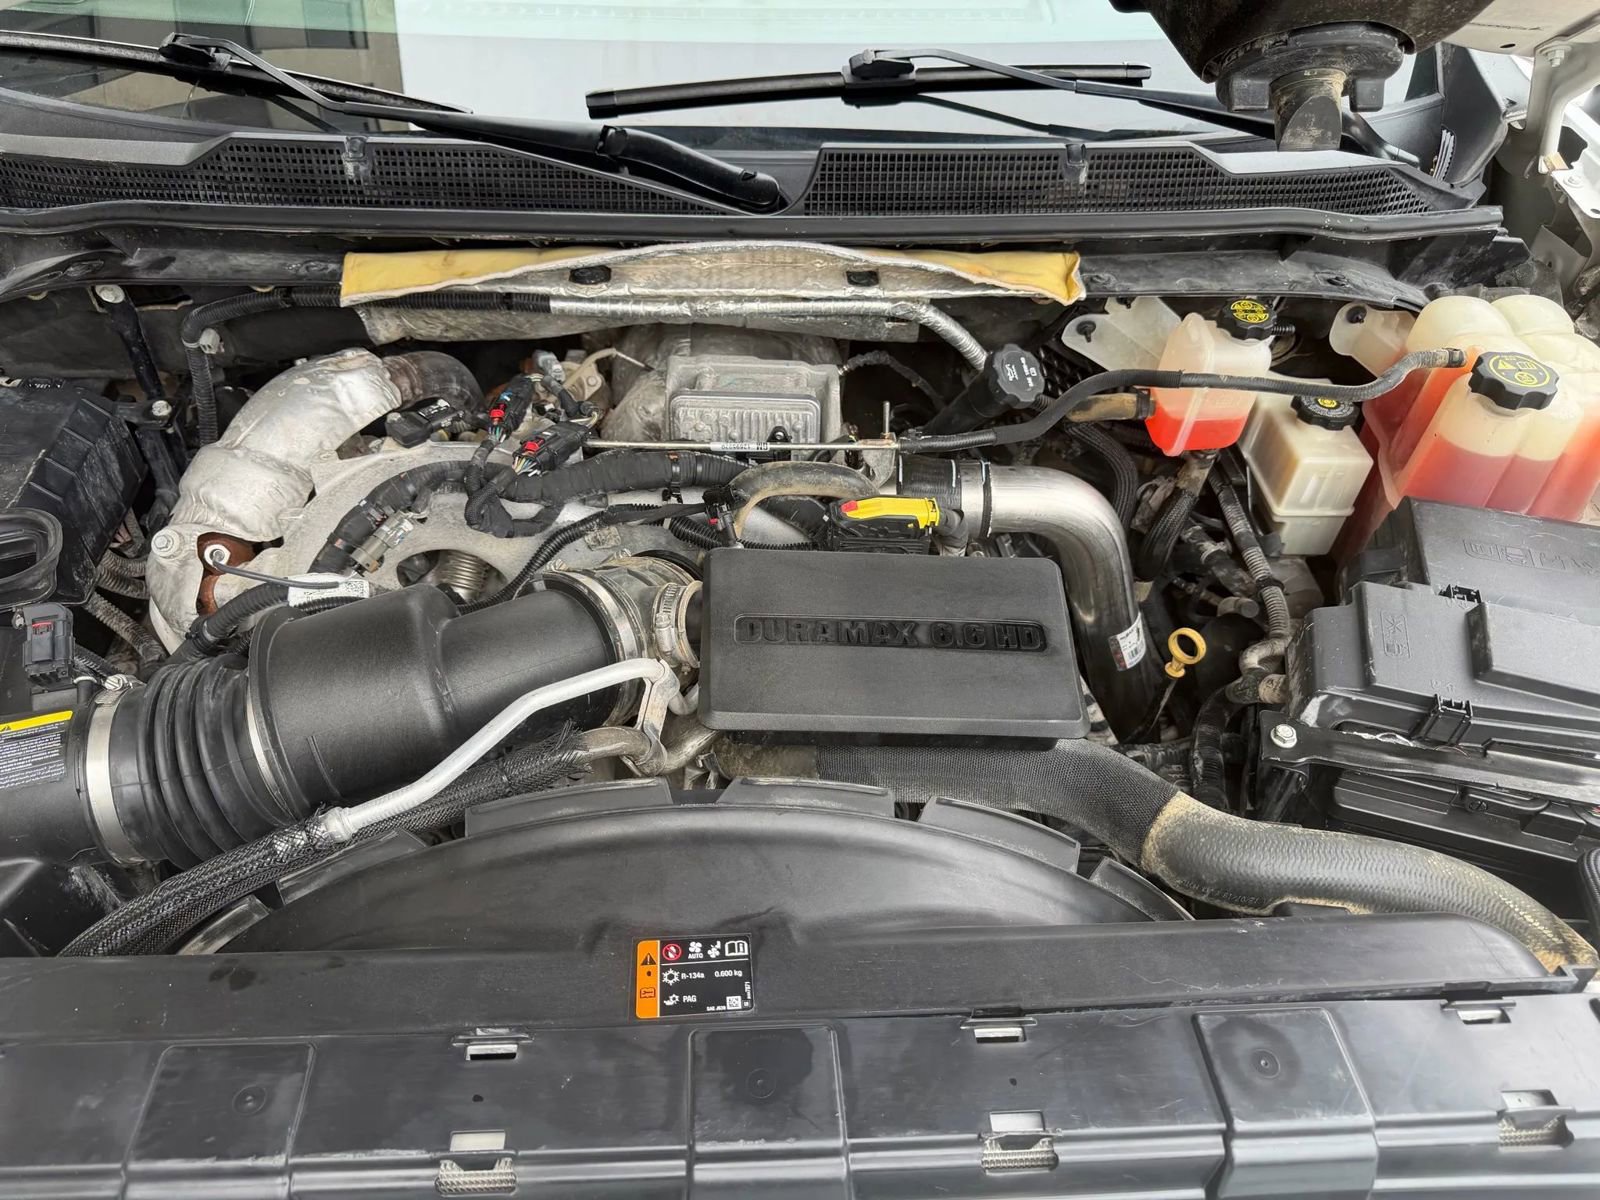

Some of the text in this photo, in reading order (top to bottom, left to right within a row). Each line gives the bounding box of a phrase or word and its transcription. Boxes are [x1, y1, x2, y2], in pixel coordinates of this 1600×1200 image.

[740, 619, 1043, 651] DURAMAX 6.6 HD
[681, 972, 705, 980] R-134a
[683, 995, 697, 1003] PAG
